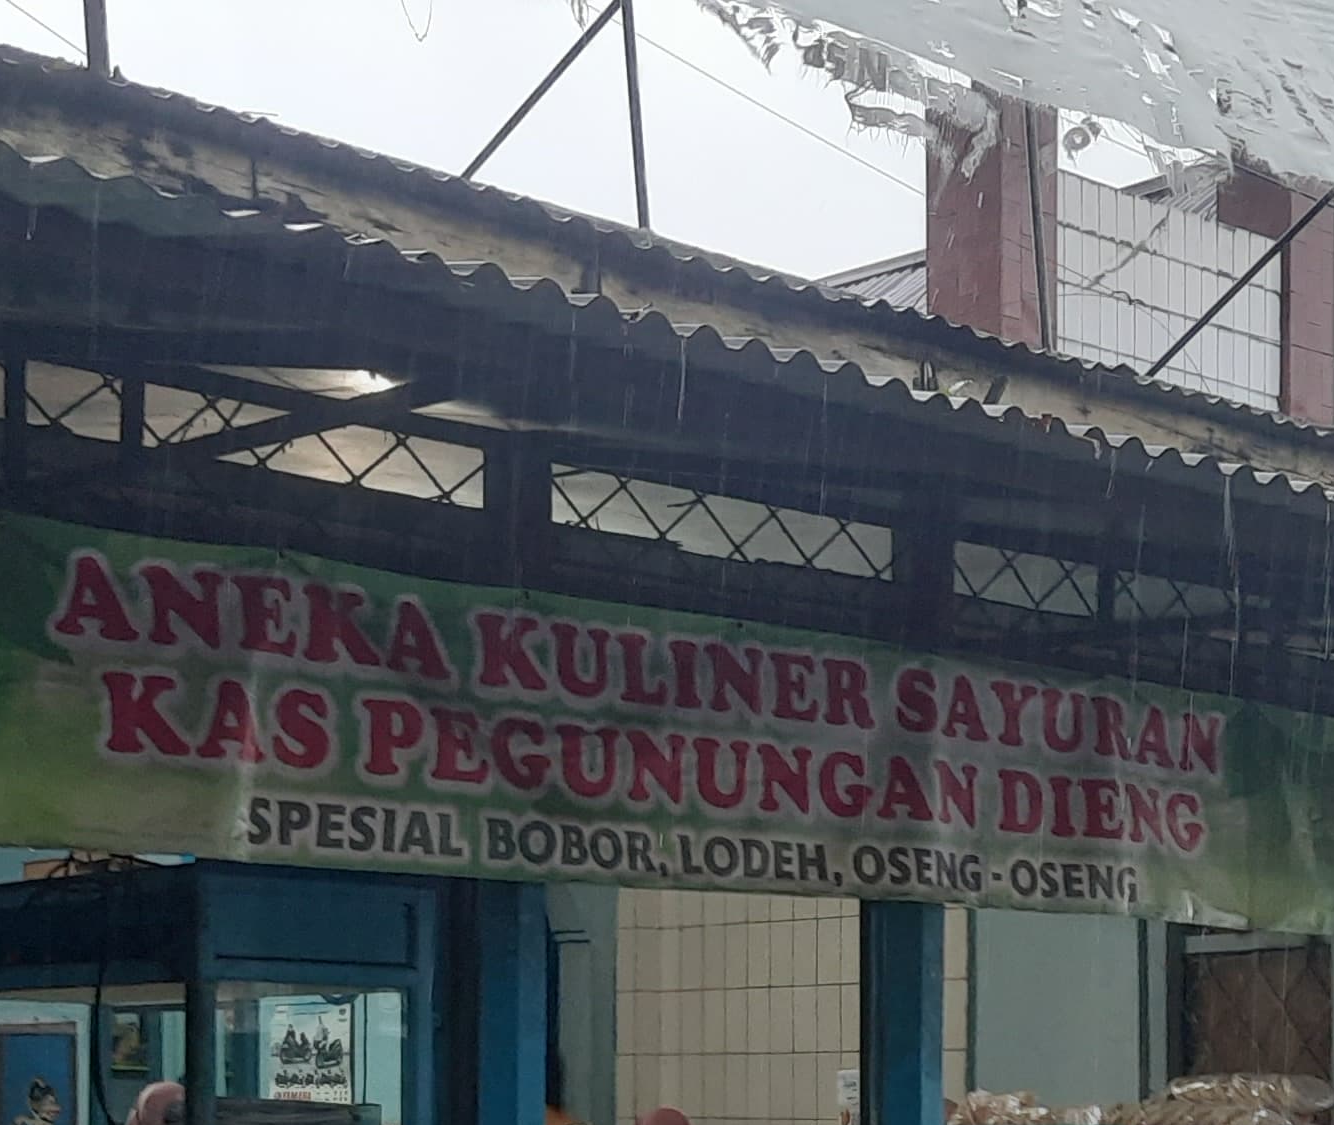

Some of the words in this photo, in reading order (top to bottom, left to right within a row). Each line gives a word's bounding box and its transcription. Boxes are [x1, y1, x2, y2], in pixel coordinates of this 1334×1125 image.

[53, 555, 451, 681] ANEKA
[473, 613, 875, 730] KULINER
[896, 668, 1221, 775] SAYURAN
[102, 671, 331, 769] KAS
[362, 698, 978, 829] PEGUNUNGAN
[997, 768, 1206, 852] DIENG
[247, 797, 463, 857] SPESIAL
[486, 818, 668, 878] BOBOR,
[678, 833, 844, 887] LODEH,
